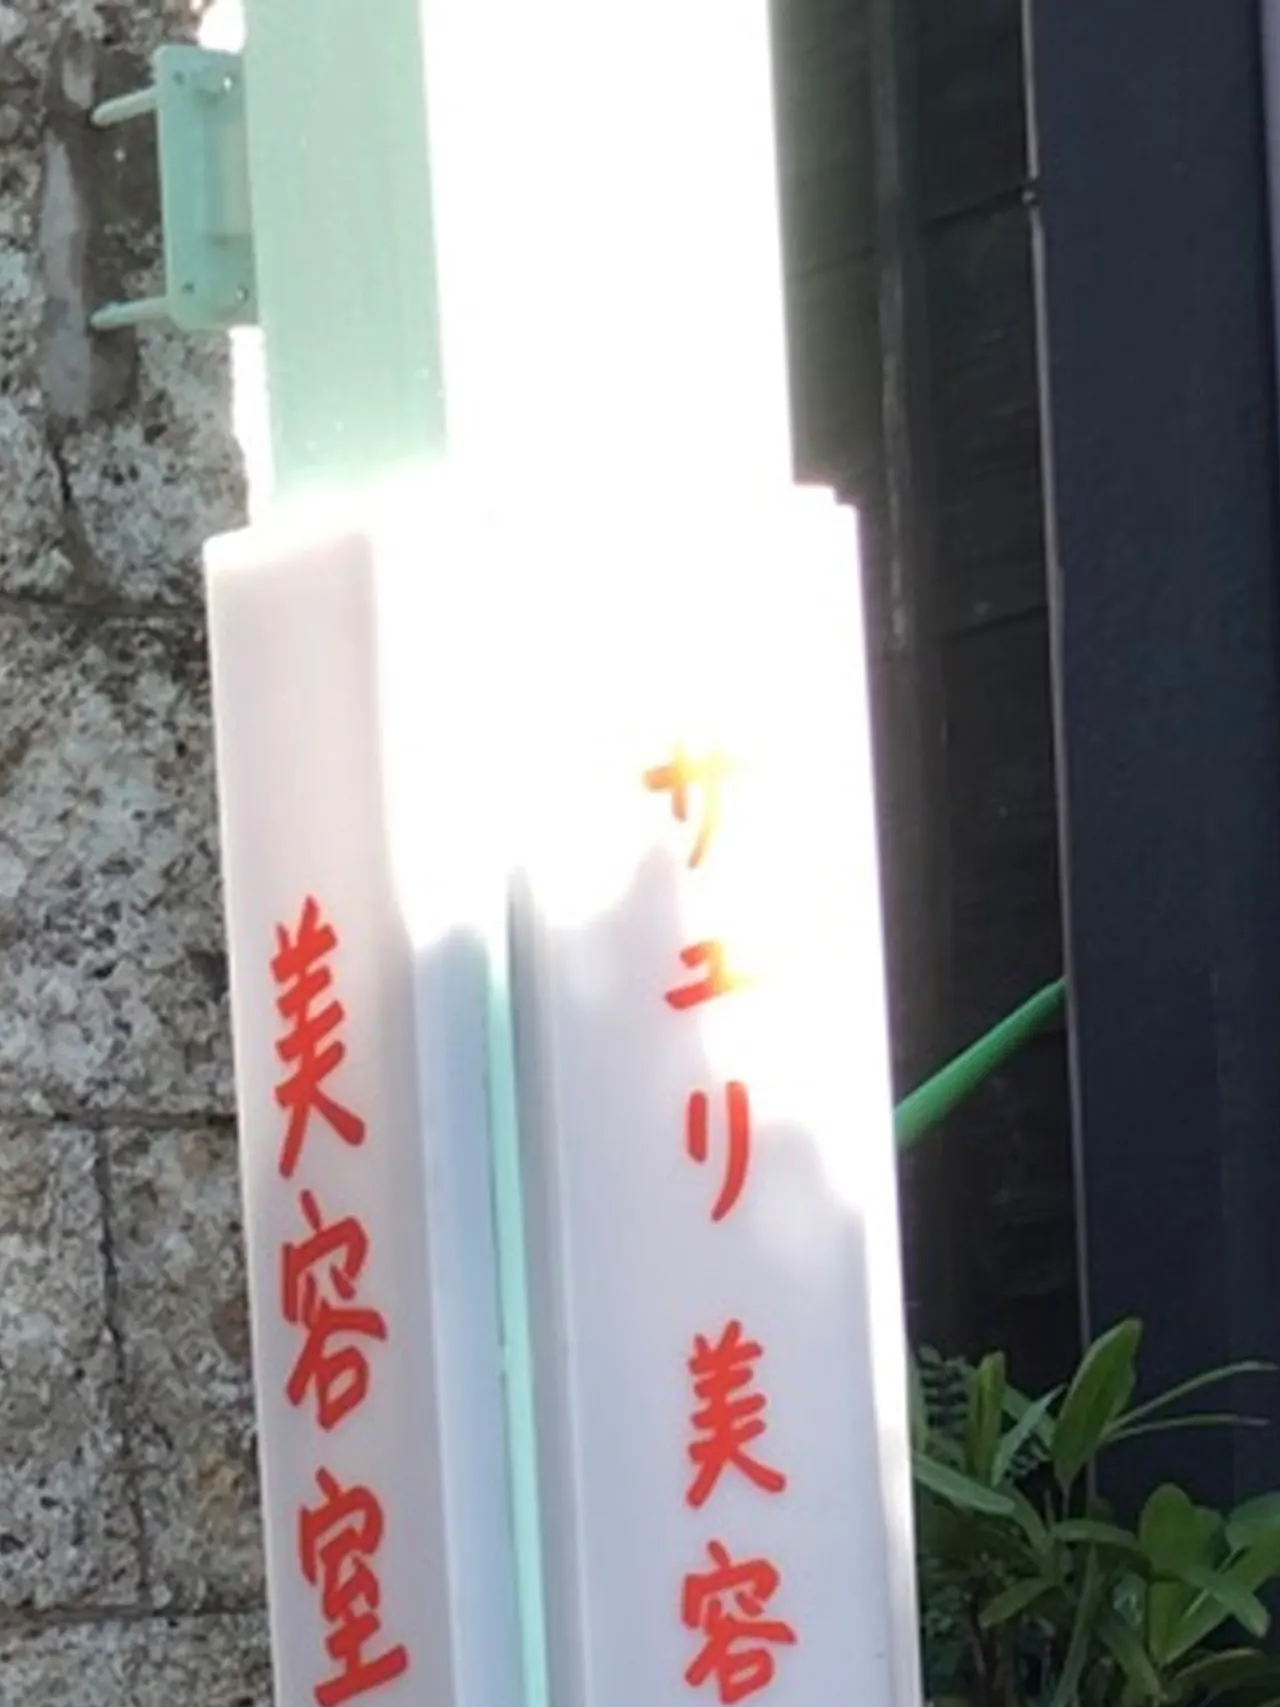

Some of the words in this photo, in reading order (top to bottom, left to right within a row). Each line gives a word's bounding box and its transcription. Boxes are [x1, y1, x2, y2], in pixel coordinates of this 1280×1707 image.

[269, 894, 409, 1707] 美容室
[643, 747, 754, 1222] サユリ
